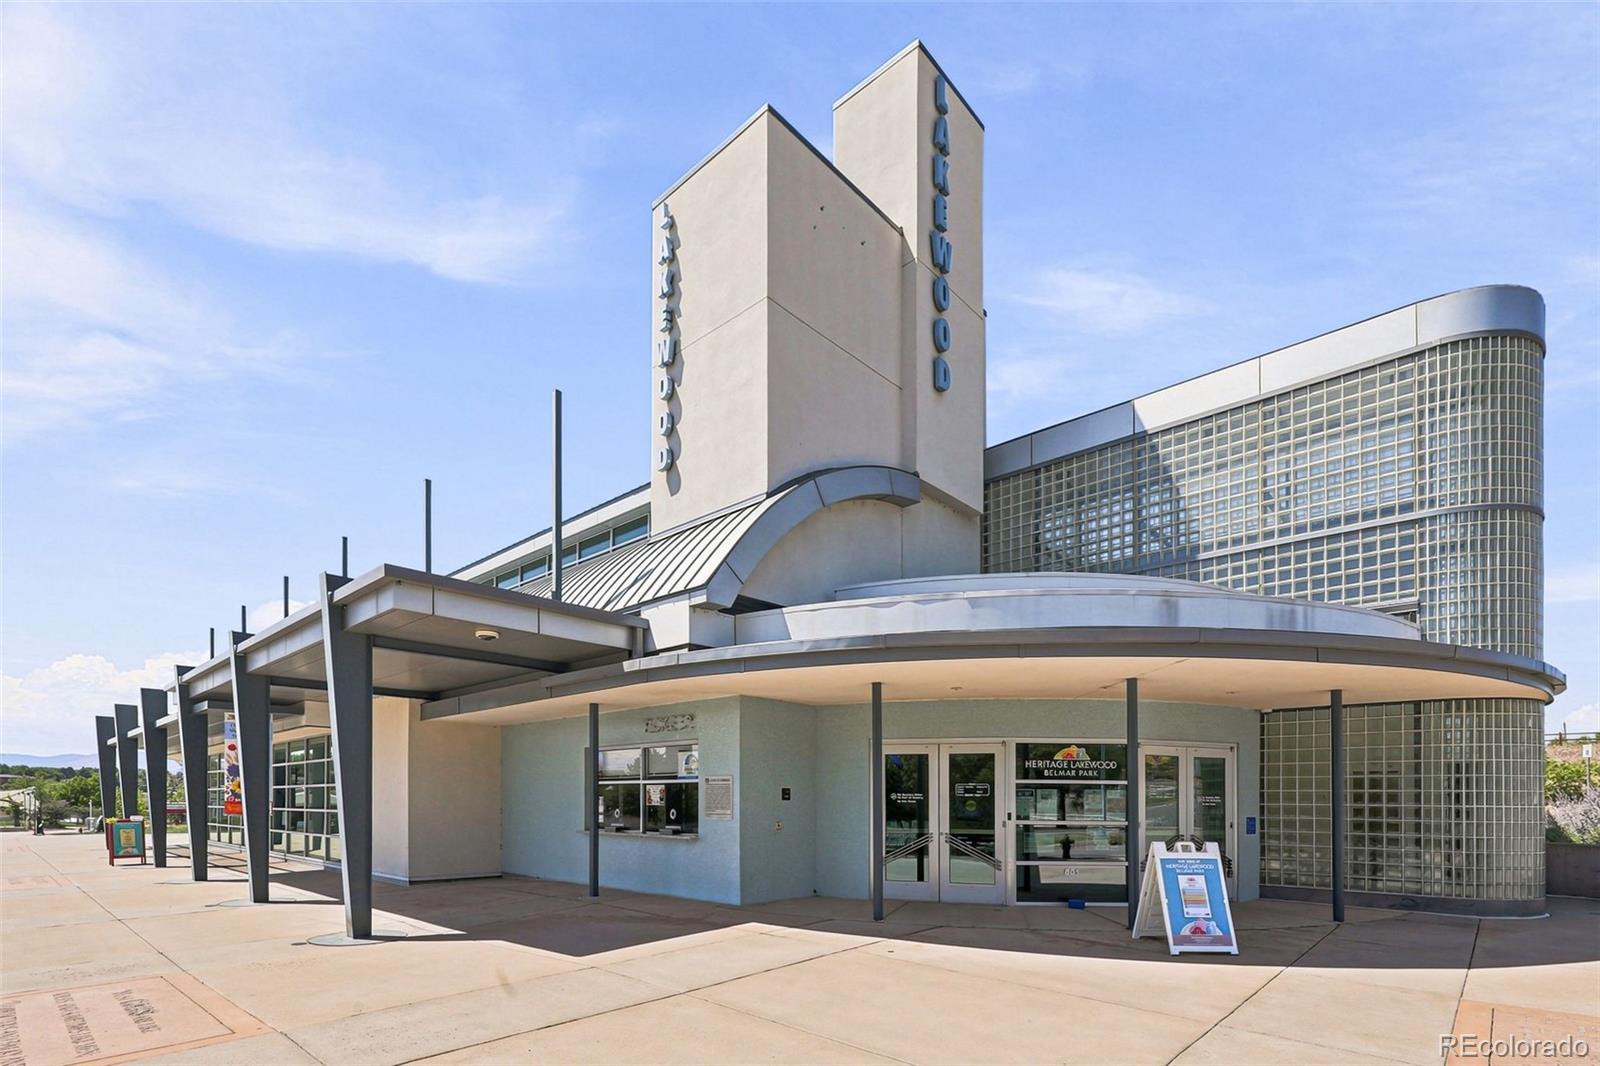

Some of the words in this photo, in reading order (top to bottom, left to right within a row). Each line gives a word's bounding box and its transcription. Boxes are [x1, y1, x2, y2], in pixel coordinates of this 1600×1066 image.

[930, 75, 952, 393] LAKEWOOD
[657, 202, 677, 473] LAKEWOOD
[1025, 760, 1068, 769] HERITAGE
[1070, 760, 1118, 769] LAKEWOOD
[1043, 769, 1077, 777] BELMAR
[1078, 769, 1099, 777] PARK
